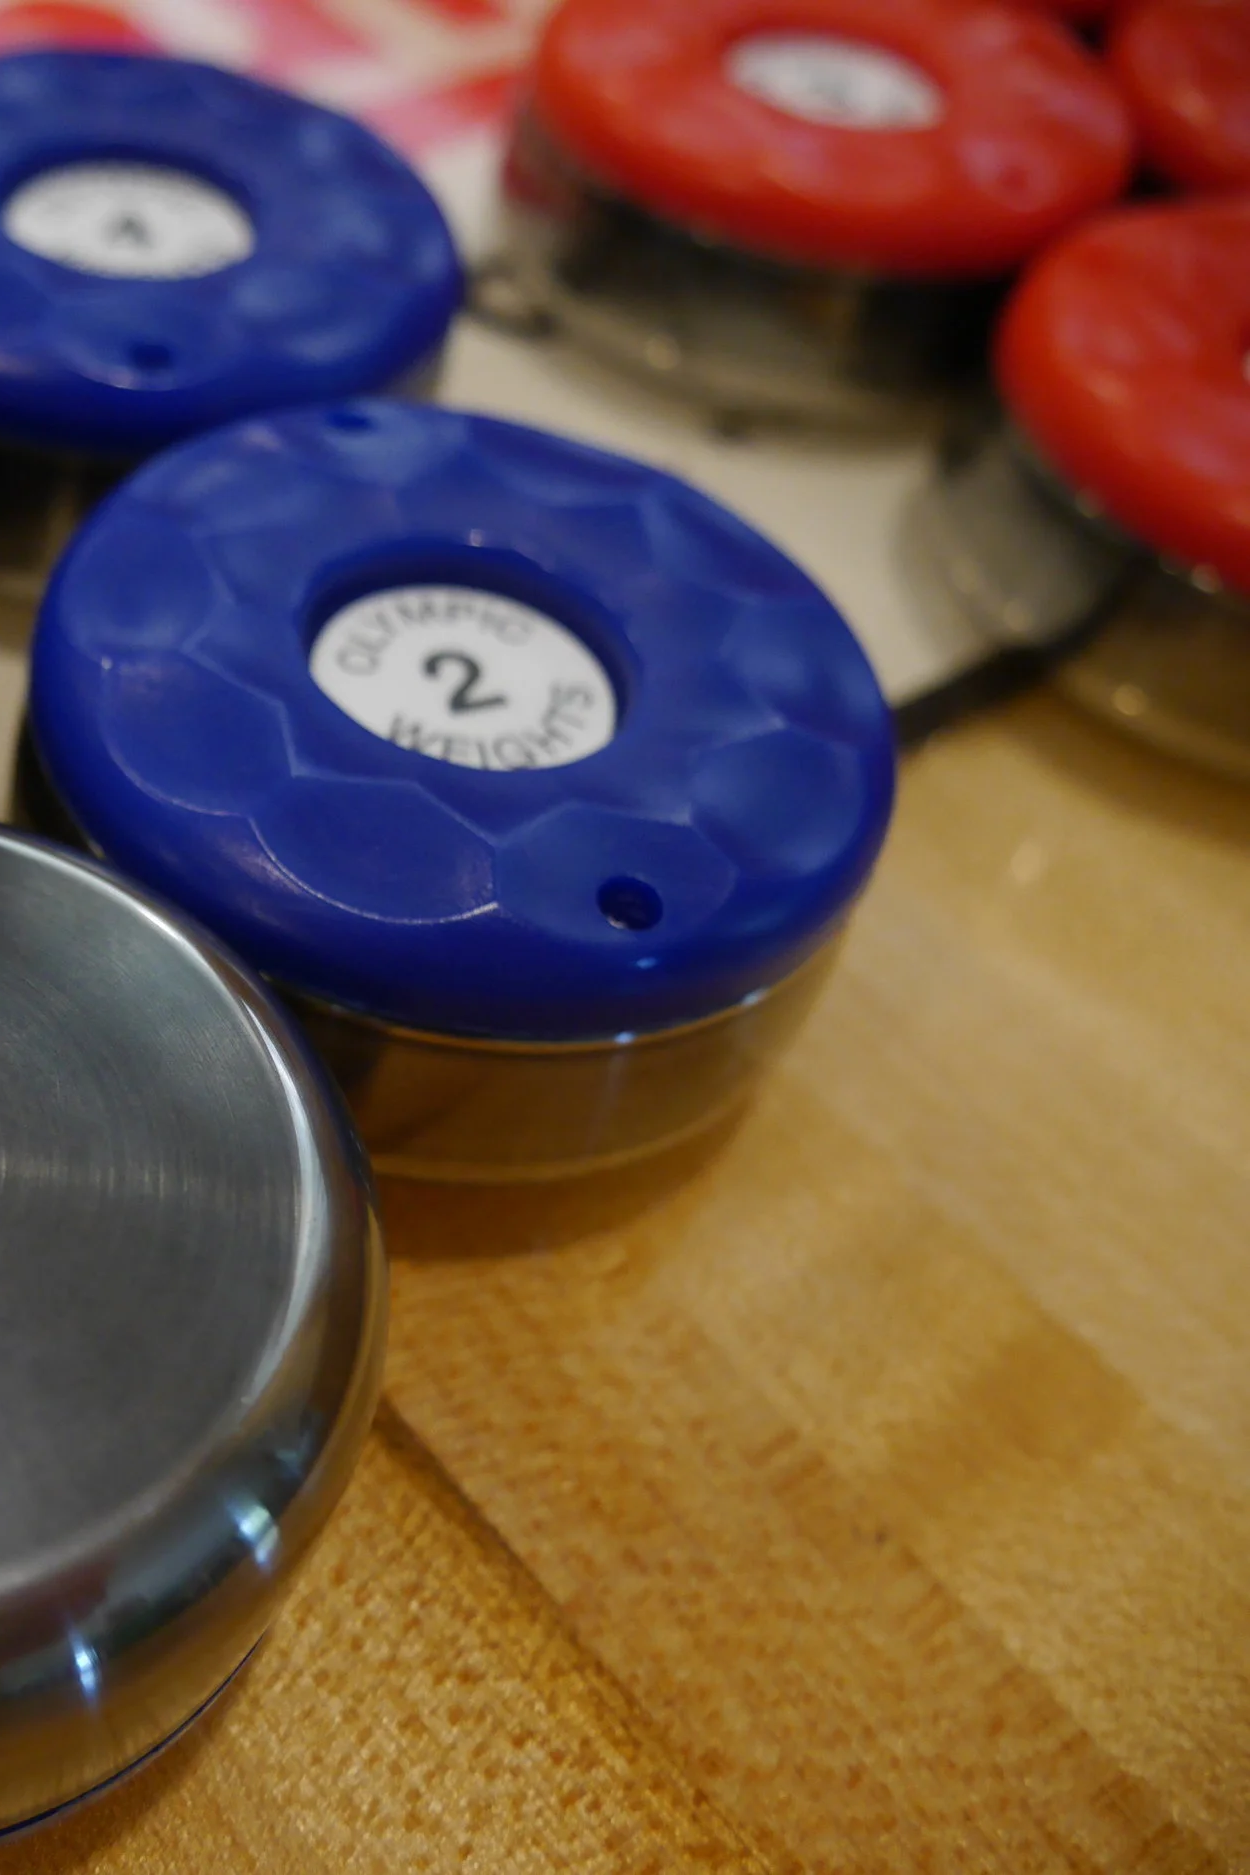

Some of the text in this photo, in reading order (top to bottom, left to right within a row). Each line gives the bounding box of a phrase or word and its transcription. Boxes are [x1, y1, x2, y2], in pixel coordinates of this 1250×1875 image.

[333, 594, 534, 678] OLYMPIC
[422, 648, 508, 718] 2
[389, 682, 596, 772] WEIGHTS
